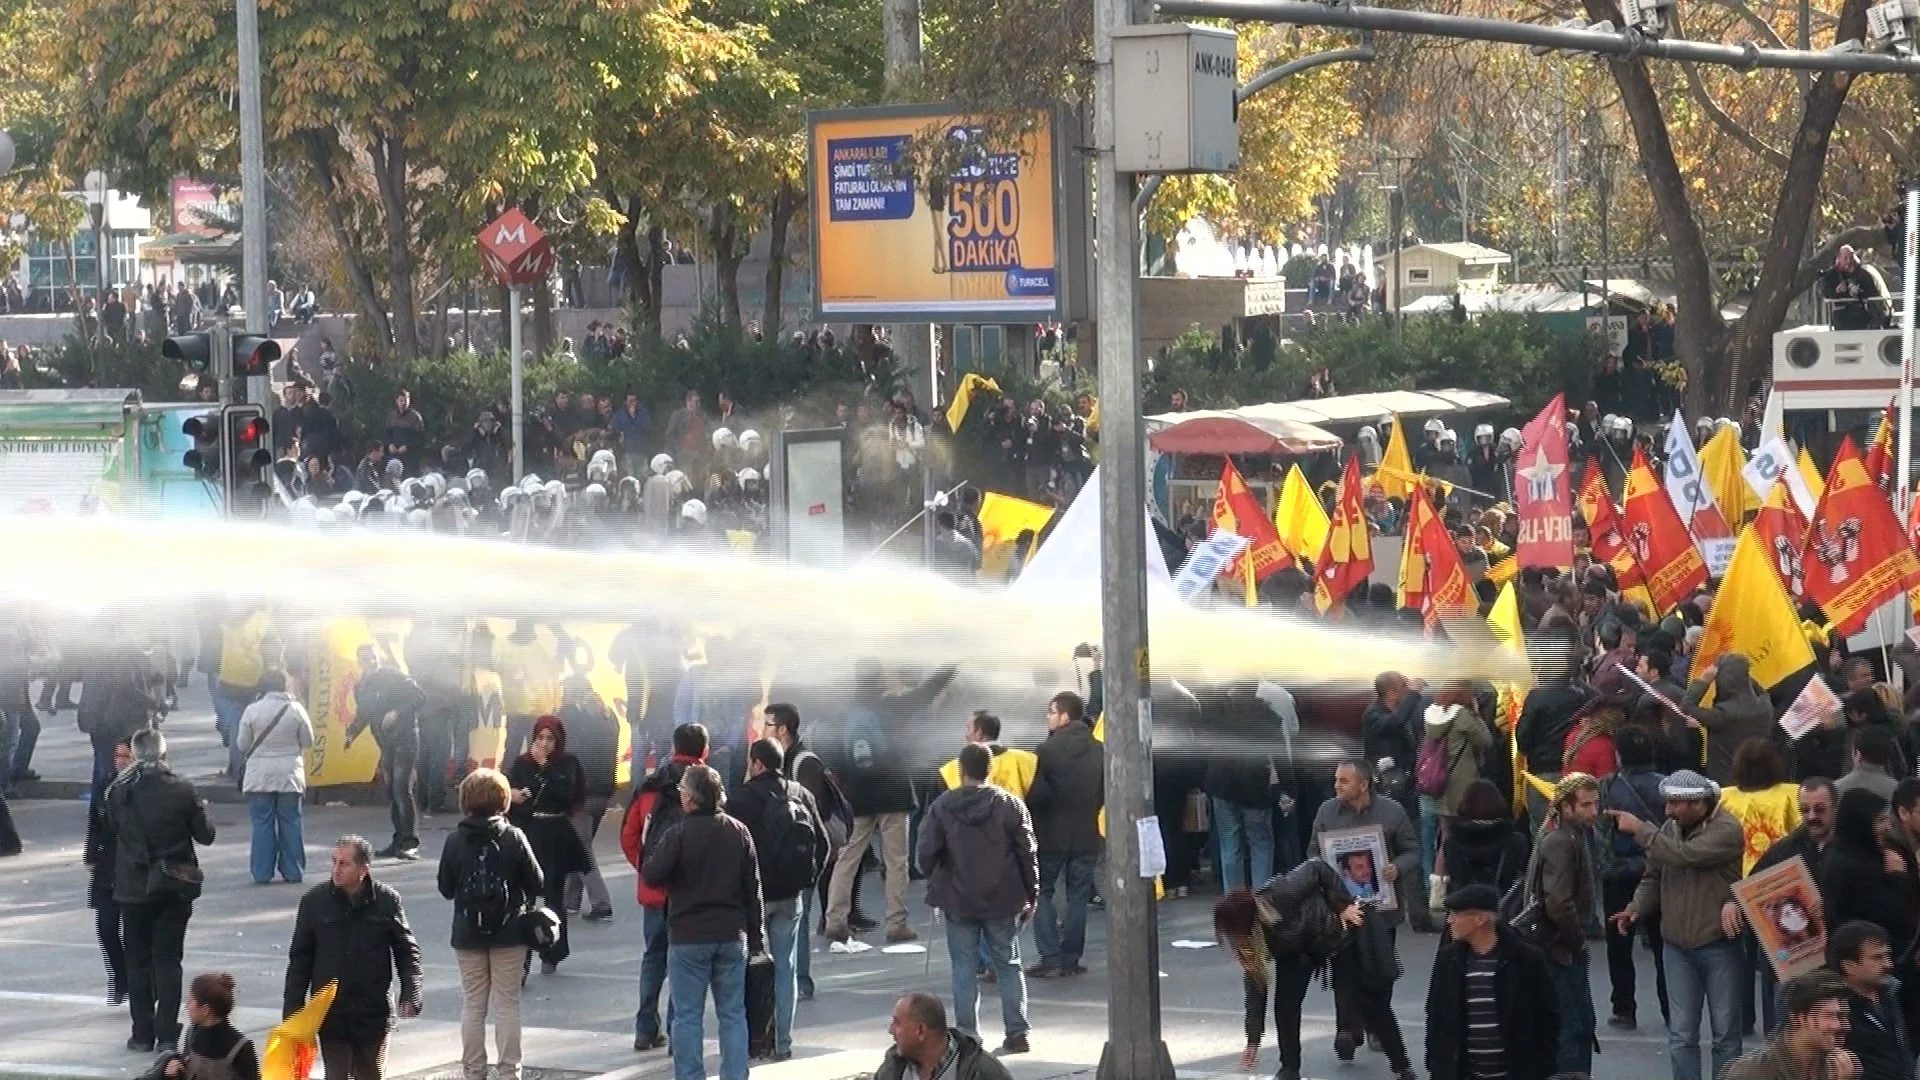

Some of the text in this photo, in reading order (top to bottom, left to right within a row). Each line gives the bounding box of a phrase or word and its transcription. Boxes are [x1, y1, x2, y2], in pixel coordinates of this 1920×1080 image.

[835, 181, 869, 194] FATURALI
[835, 198, 852, 212] TAM
[951, 179, 1018, 239] 500
[494, 223, 527, 246] M
[515, 249, 545, 275] M
[1019, 277, 1050, 288] TURKCELL
